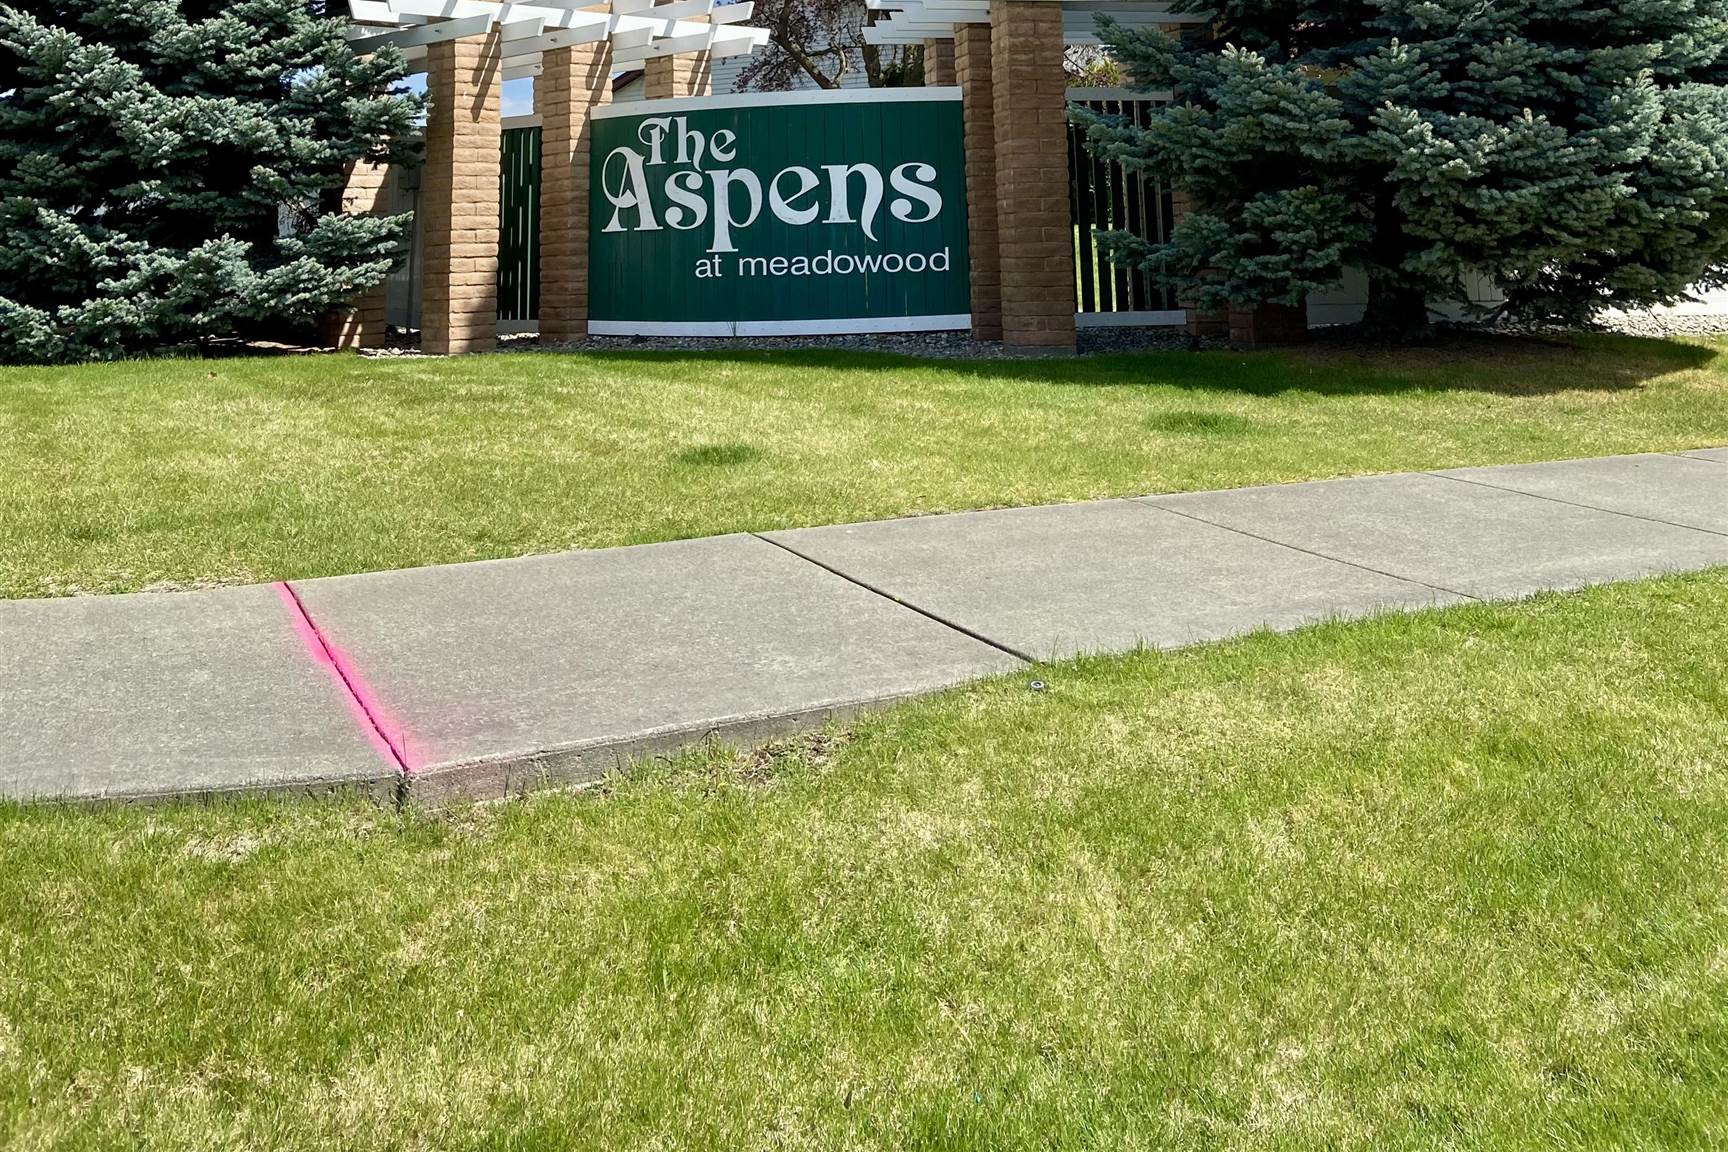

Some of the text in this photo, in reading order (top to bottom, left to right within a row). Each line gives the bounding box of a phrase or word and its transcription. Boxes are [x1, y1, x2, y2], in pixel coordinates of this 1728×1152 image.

[637, 116, 736, 171] The
[601, 147, 943, 253] Aspens
[695, 247, 950, 278] at meadowood
